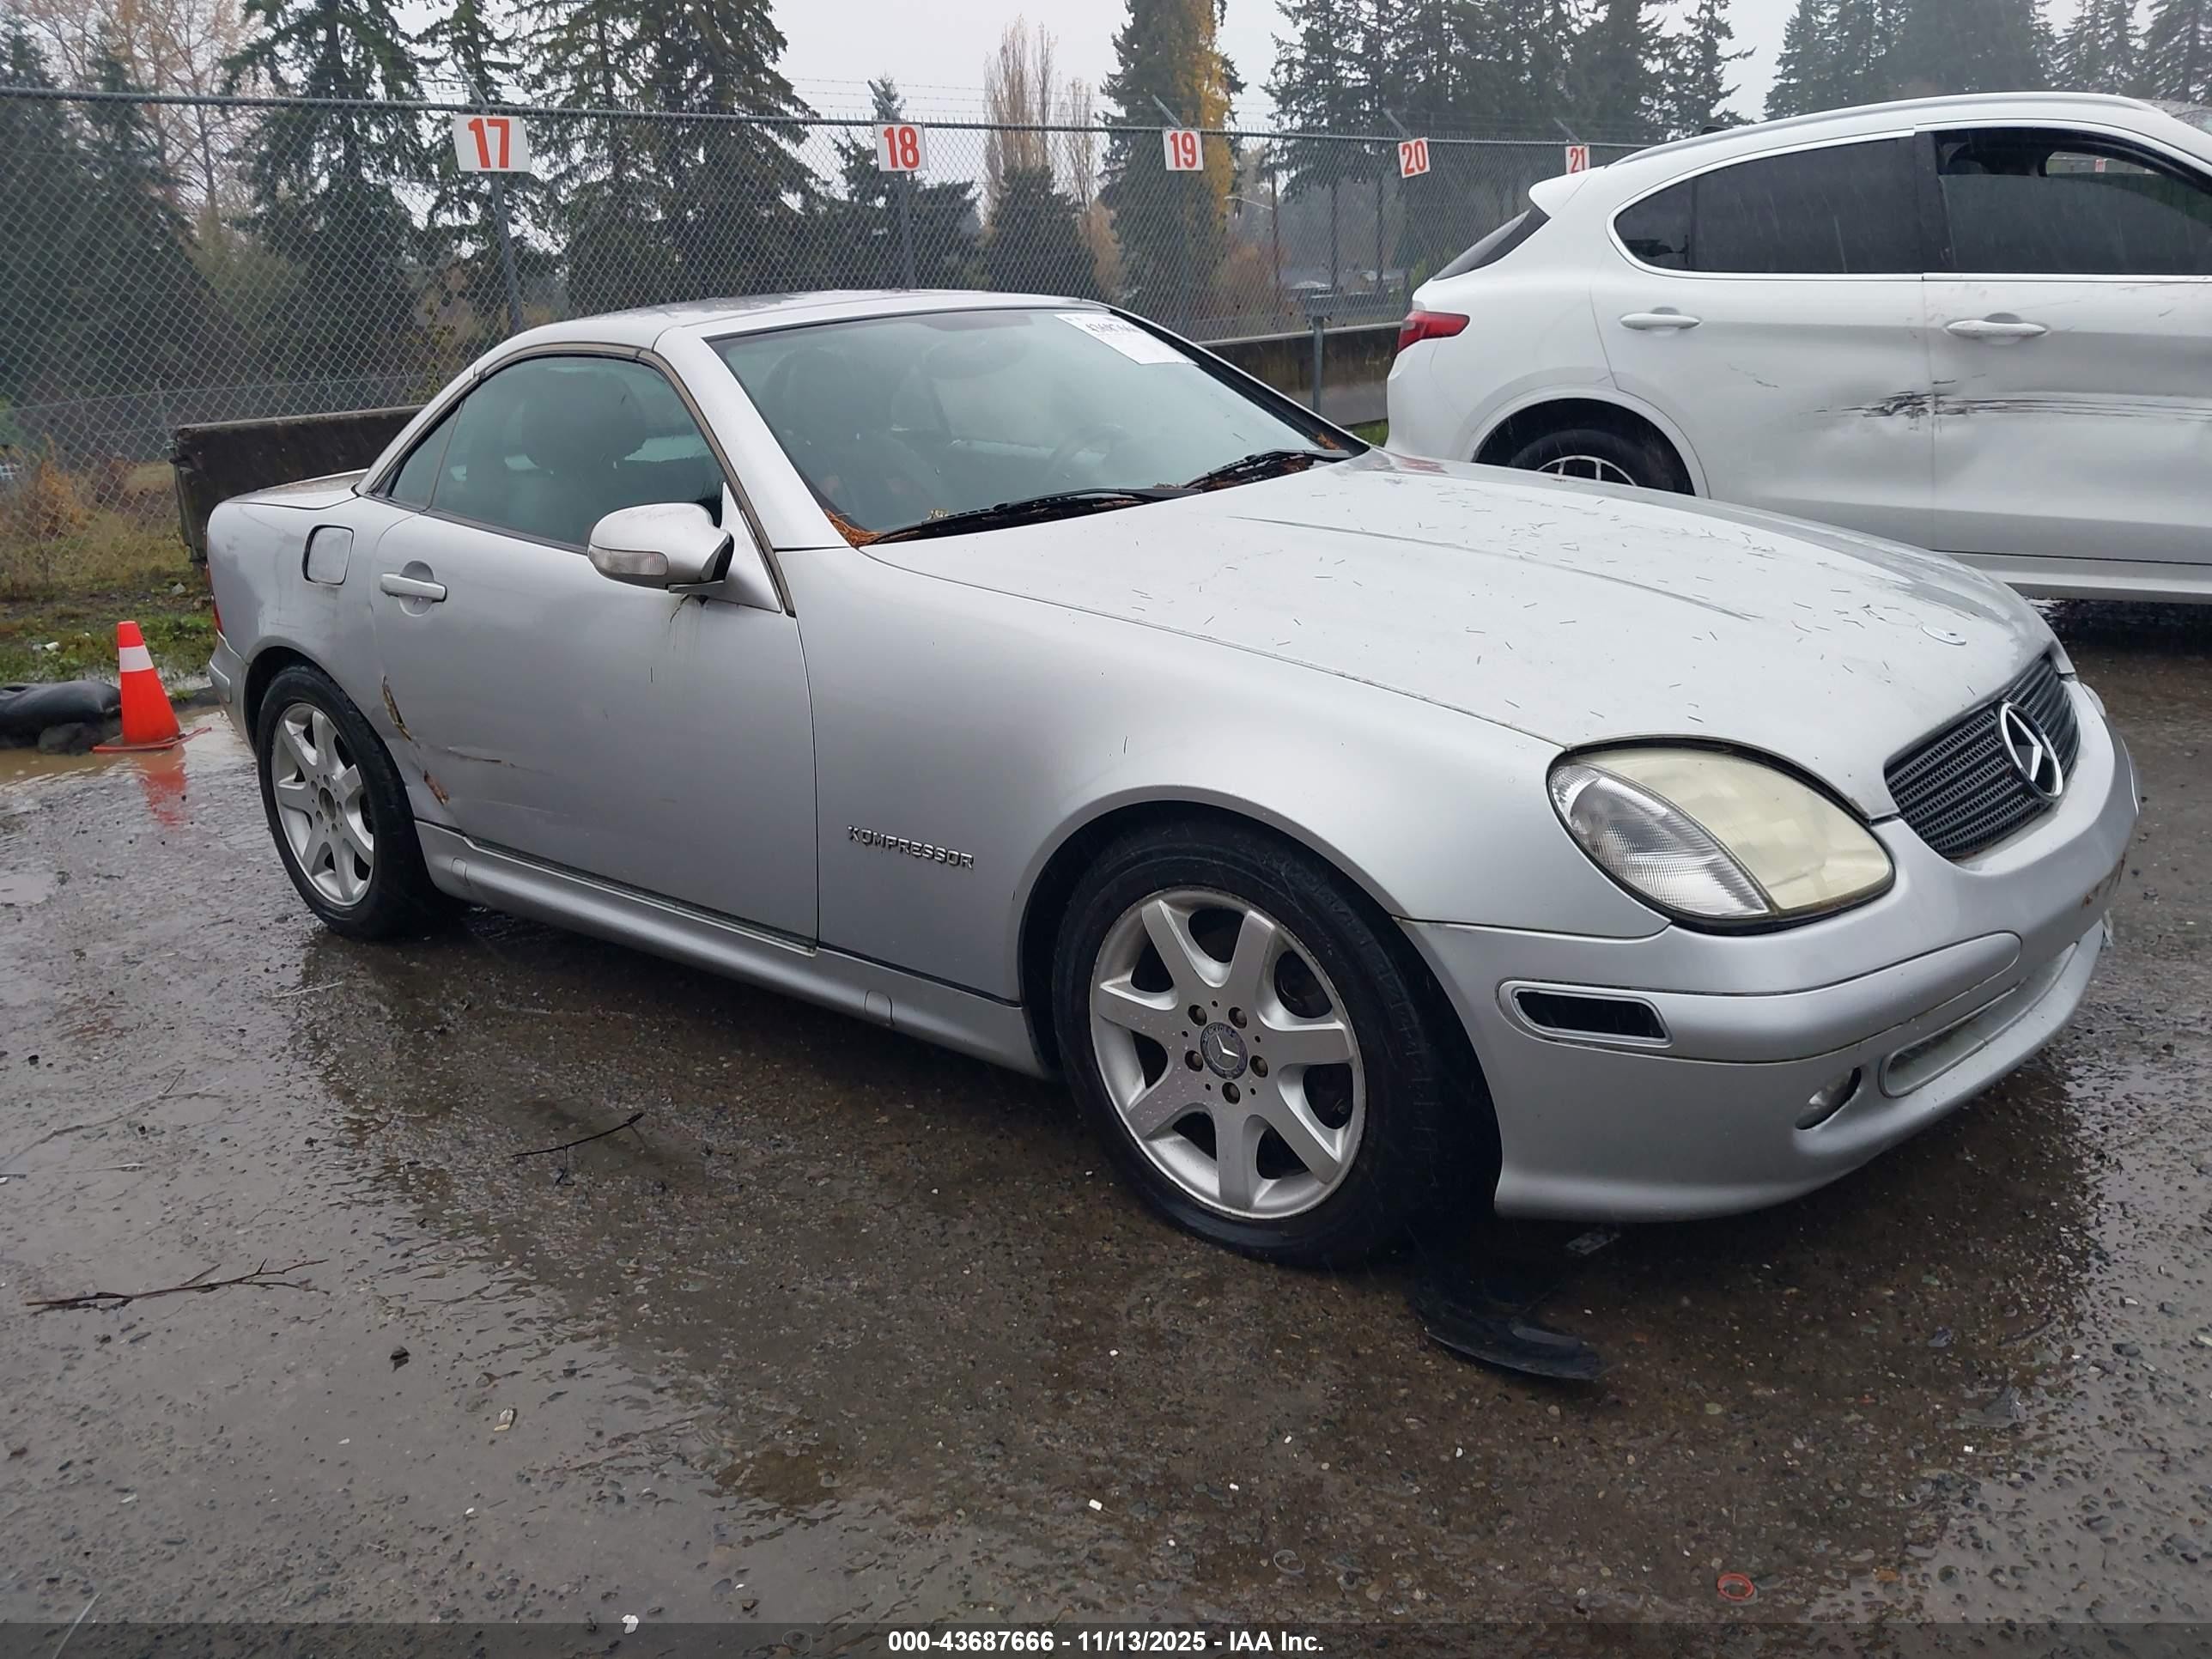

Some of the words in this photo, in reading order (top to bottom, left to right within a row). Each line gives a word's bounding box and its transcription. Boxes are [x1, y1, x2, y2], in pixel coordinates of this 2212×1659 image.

[467, 118, 510, 168] 17
[883, 126, 920, 169] 18
[1170, 132, 1197, 168] 19
[1401, 140, 1426, 174] 20
[1570, 147, 1585, 173] 21
[848, 825, 975, 869] KOMPRESSOR
